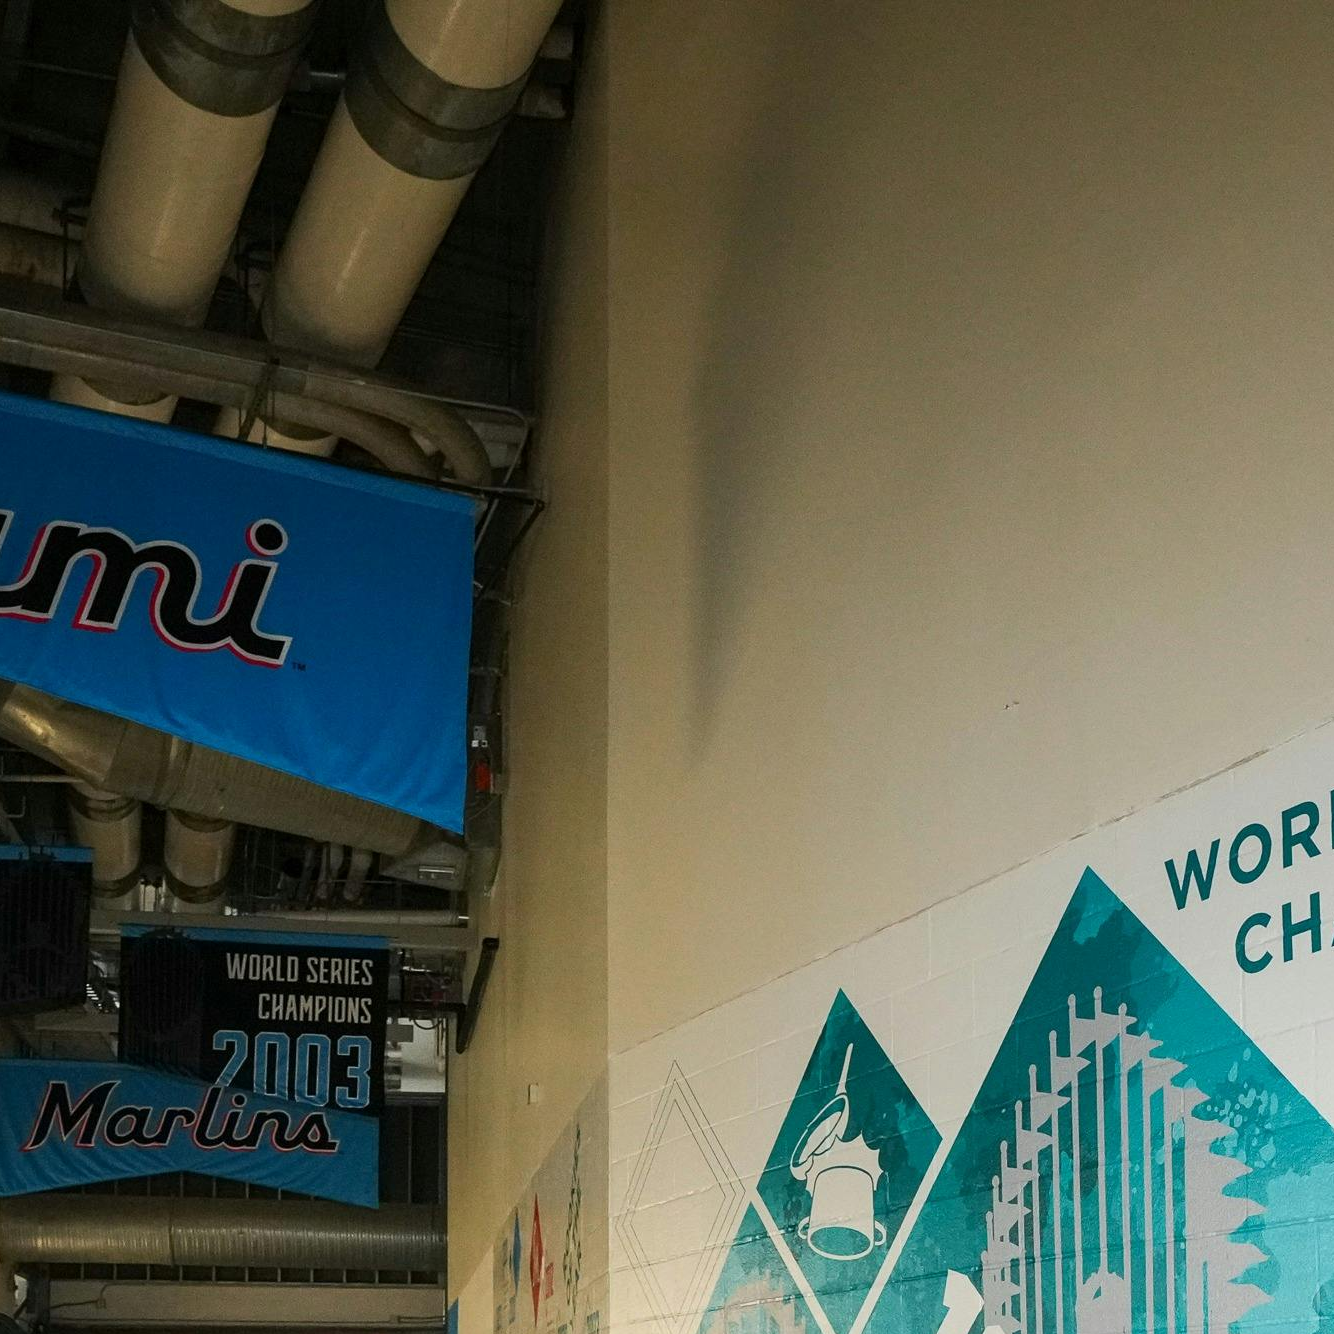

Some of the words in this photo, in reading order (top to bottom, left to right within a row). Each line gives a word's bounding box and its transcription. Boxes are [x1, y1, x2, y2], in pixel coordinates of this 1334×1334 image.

[226, 952, 300, 982] WORLD
[306, 957, 374, 986] SERIES
[258, 993, 372, 1024] CHAMPIONS
[212, 1030, 372, 1109] 2003
[20, 1080, 339, 1155] Marlins
